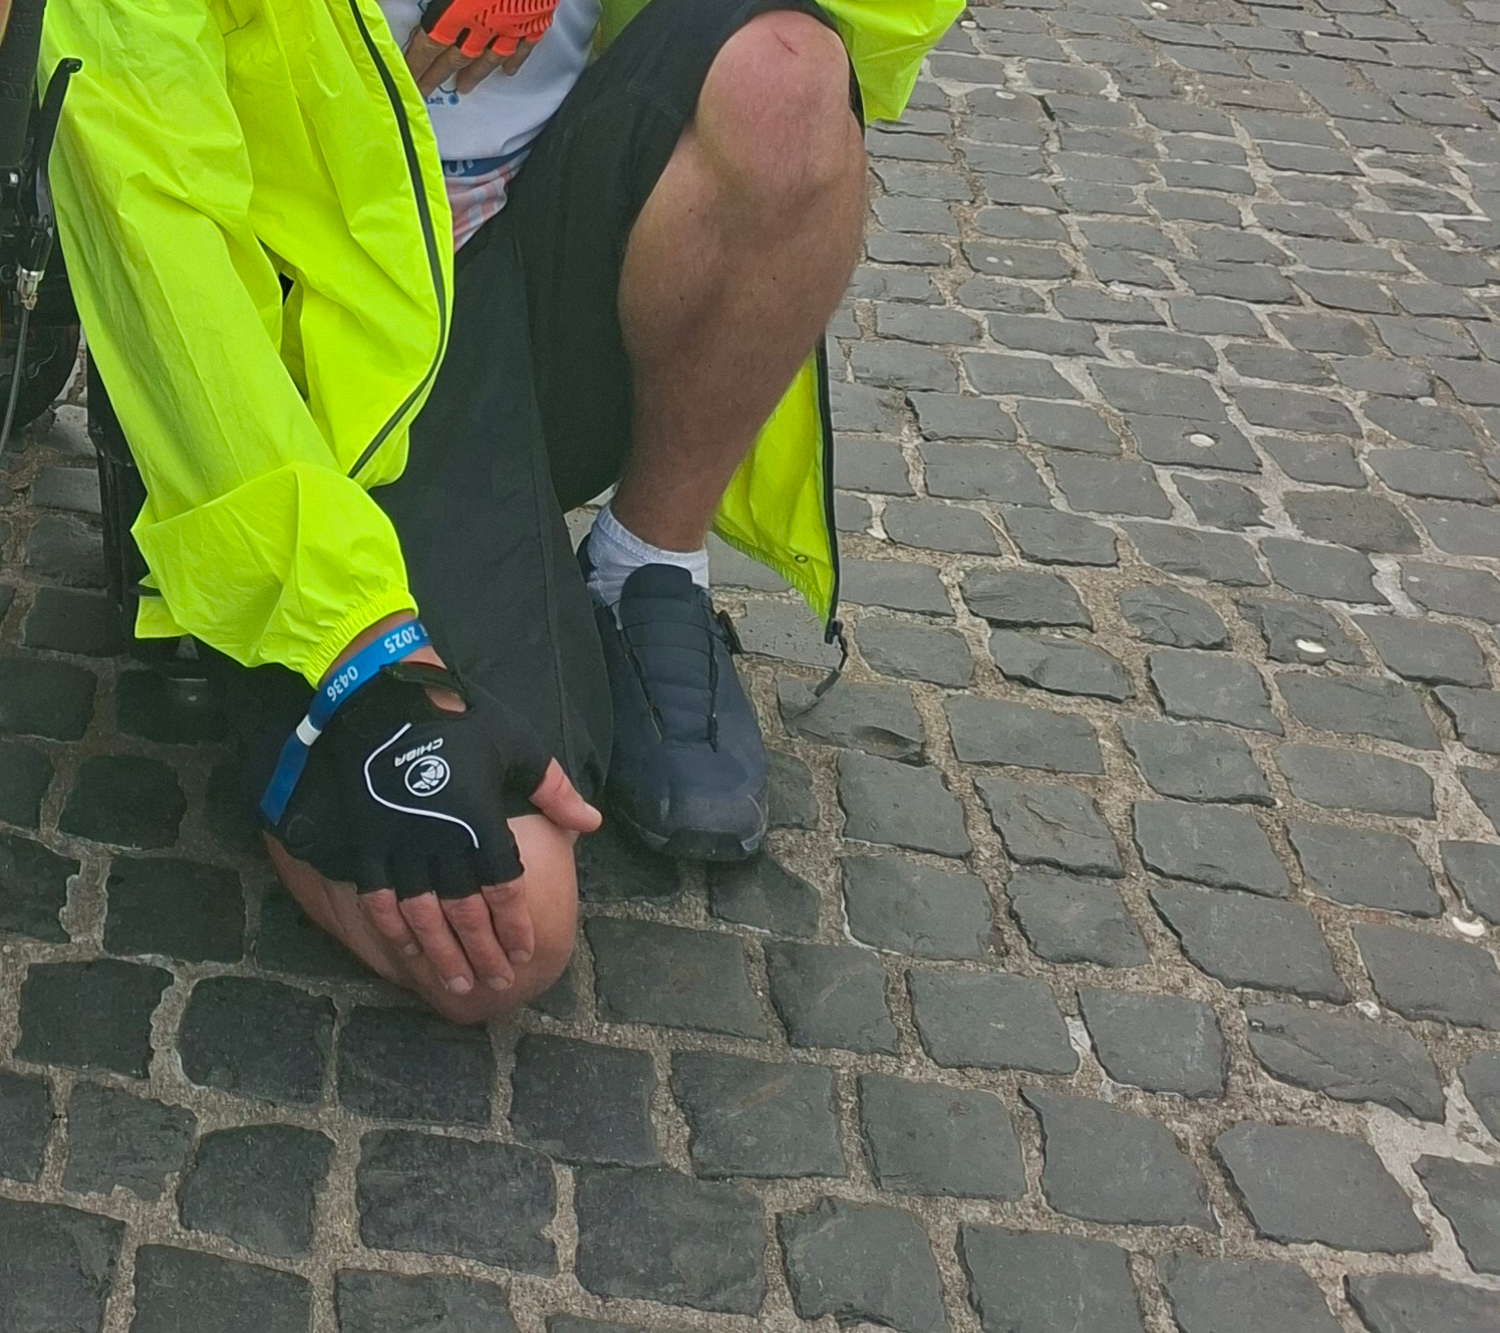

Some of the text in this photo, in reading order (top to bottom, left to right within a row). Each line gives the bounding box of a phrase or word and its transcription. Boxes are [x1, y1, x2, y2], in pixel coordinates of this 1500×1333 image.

[326, 626, 420, 702] 2025 0436
[394, 737, 444, 767] CHIBA
